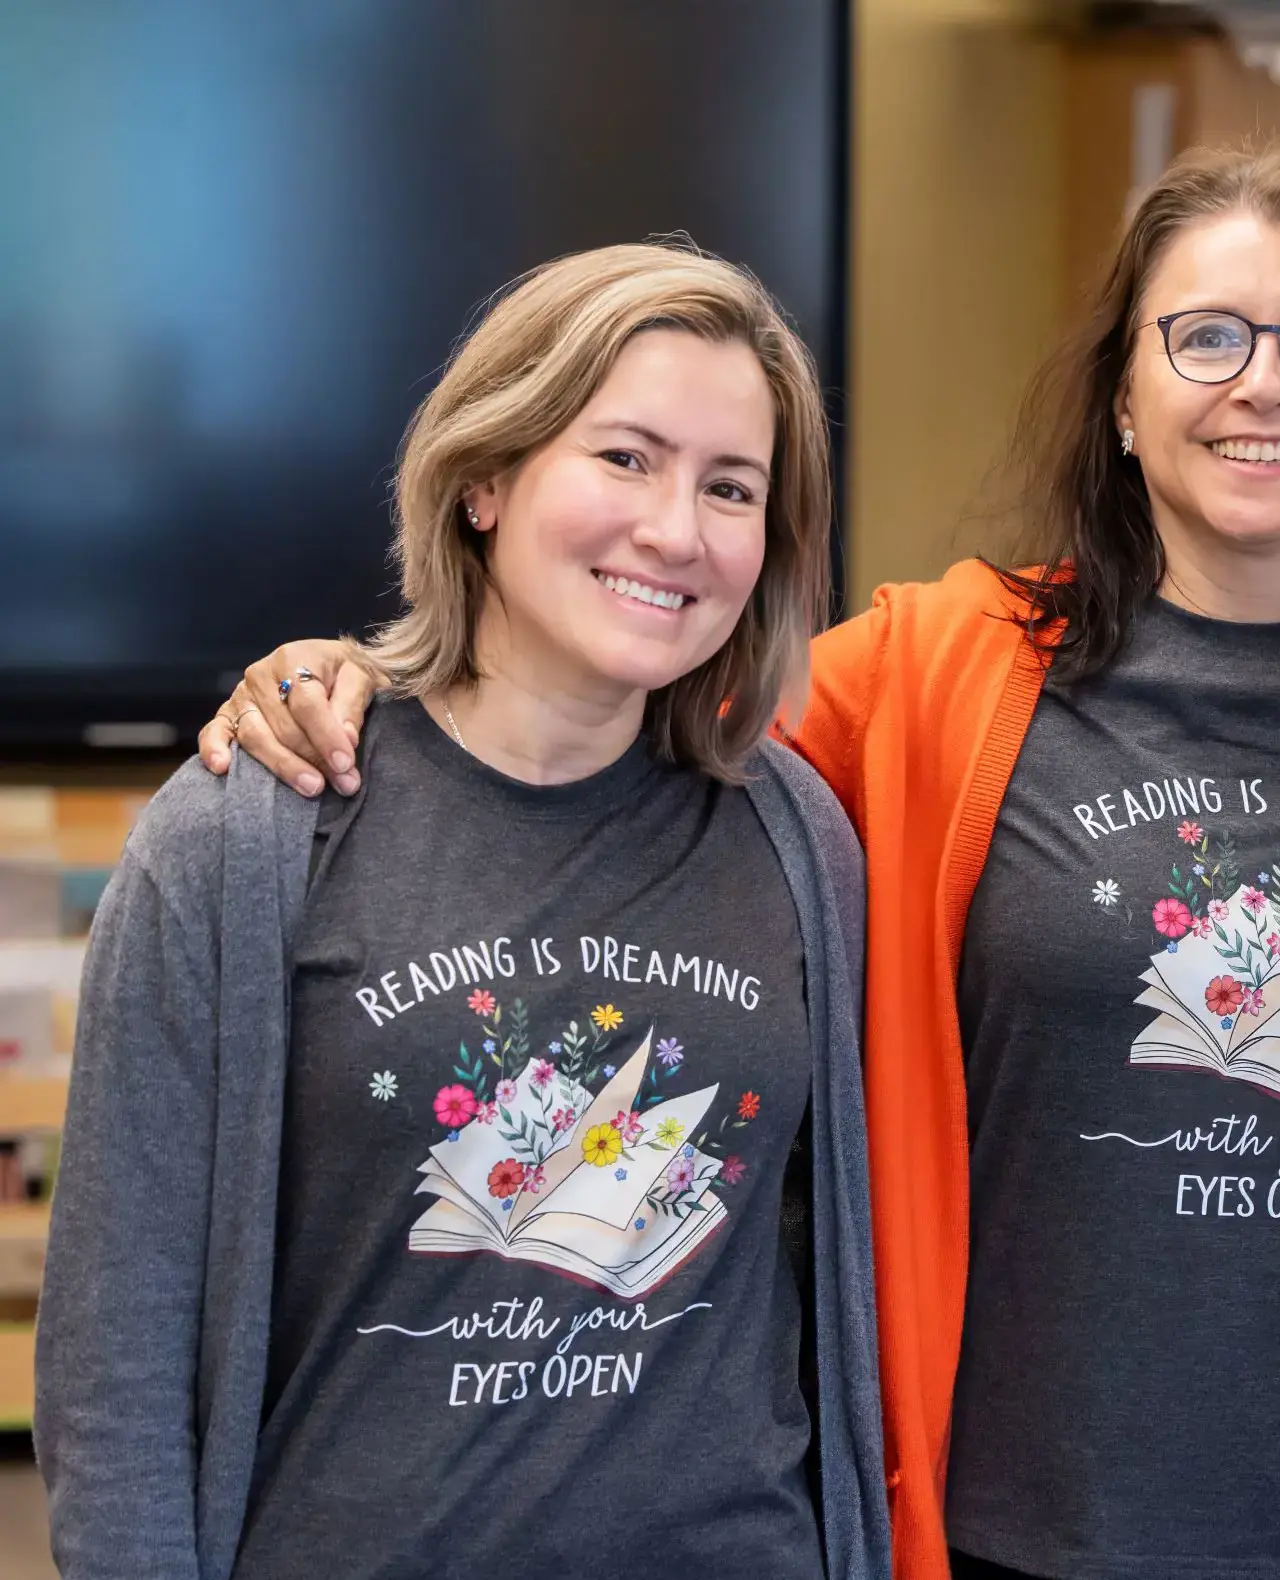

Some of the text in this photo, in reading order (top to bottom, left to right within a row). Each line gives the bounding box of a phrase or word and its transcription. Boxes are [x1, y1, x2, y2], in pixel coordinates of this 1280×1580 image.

[1073, 777, 1222, 839] READING
[1240, 778, 1267, 814] IS
[356, 935, 761, 1027] READING IS DREAMING
[1168, 1114, 1273, 1157] with
[1176, 1175, 1255, 1217] EYES
[440, 1296, 664, 1353] with your
[449, 1352, 642, 1405] EYES OPEN
